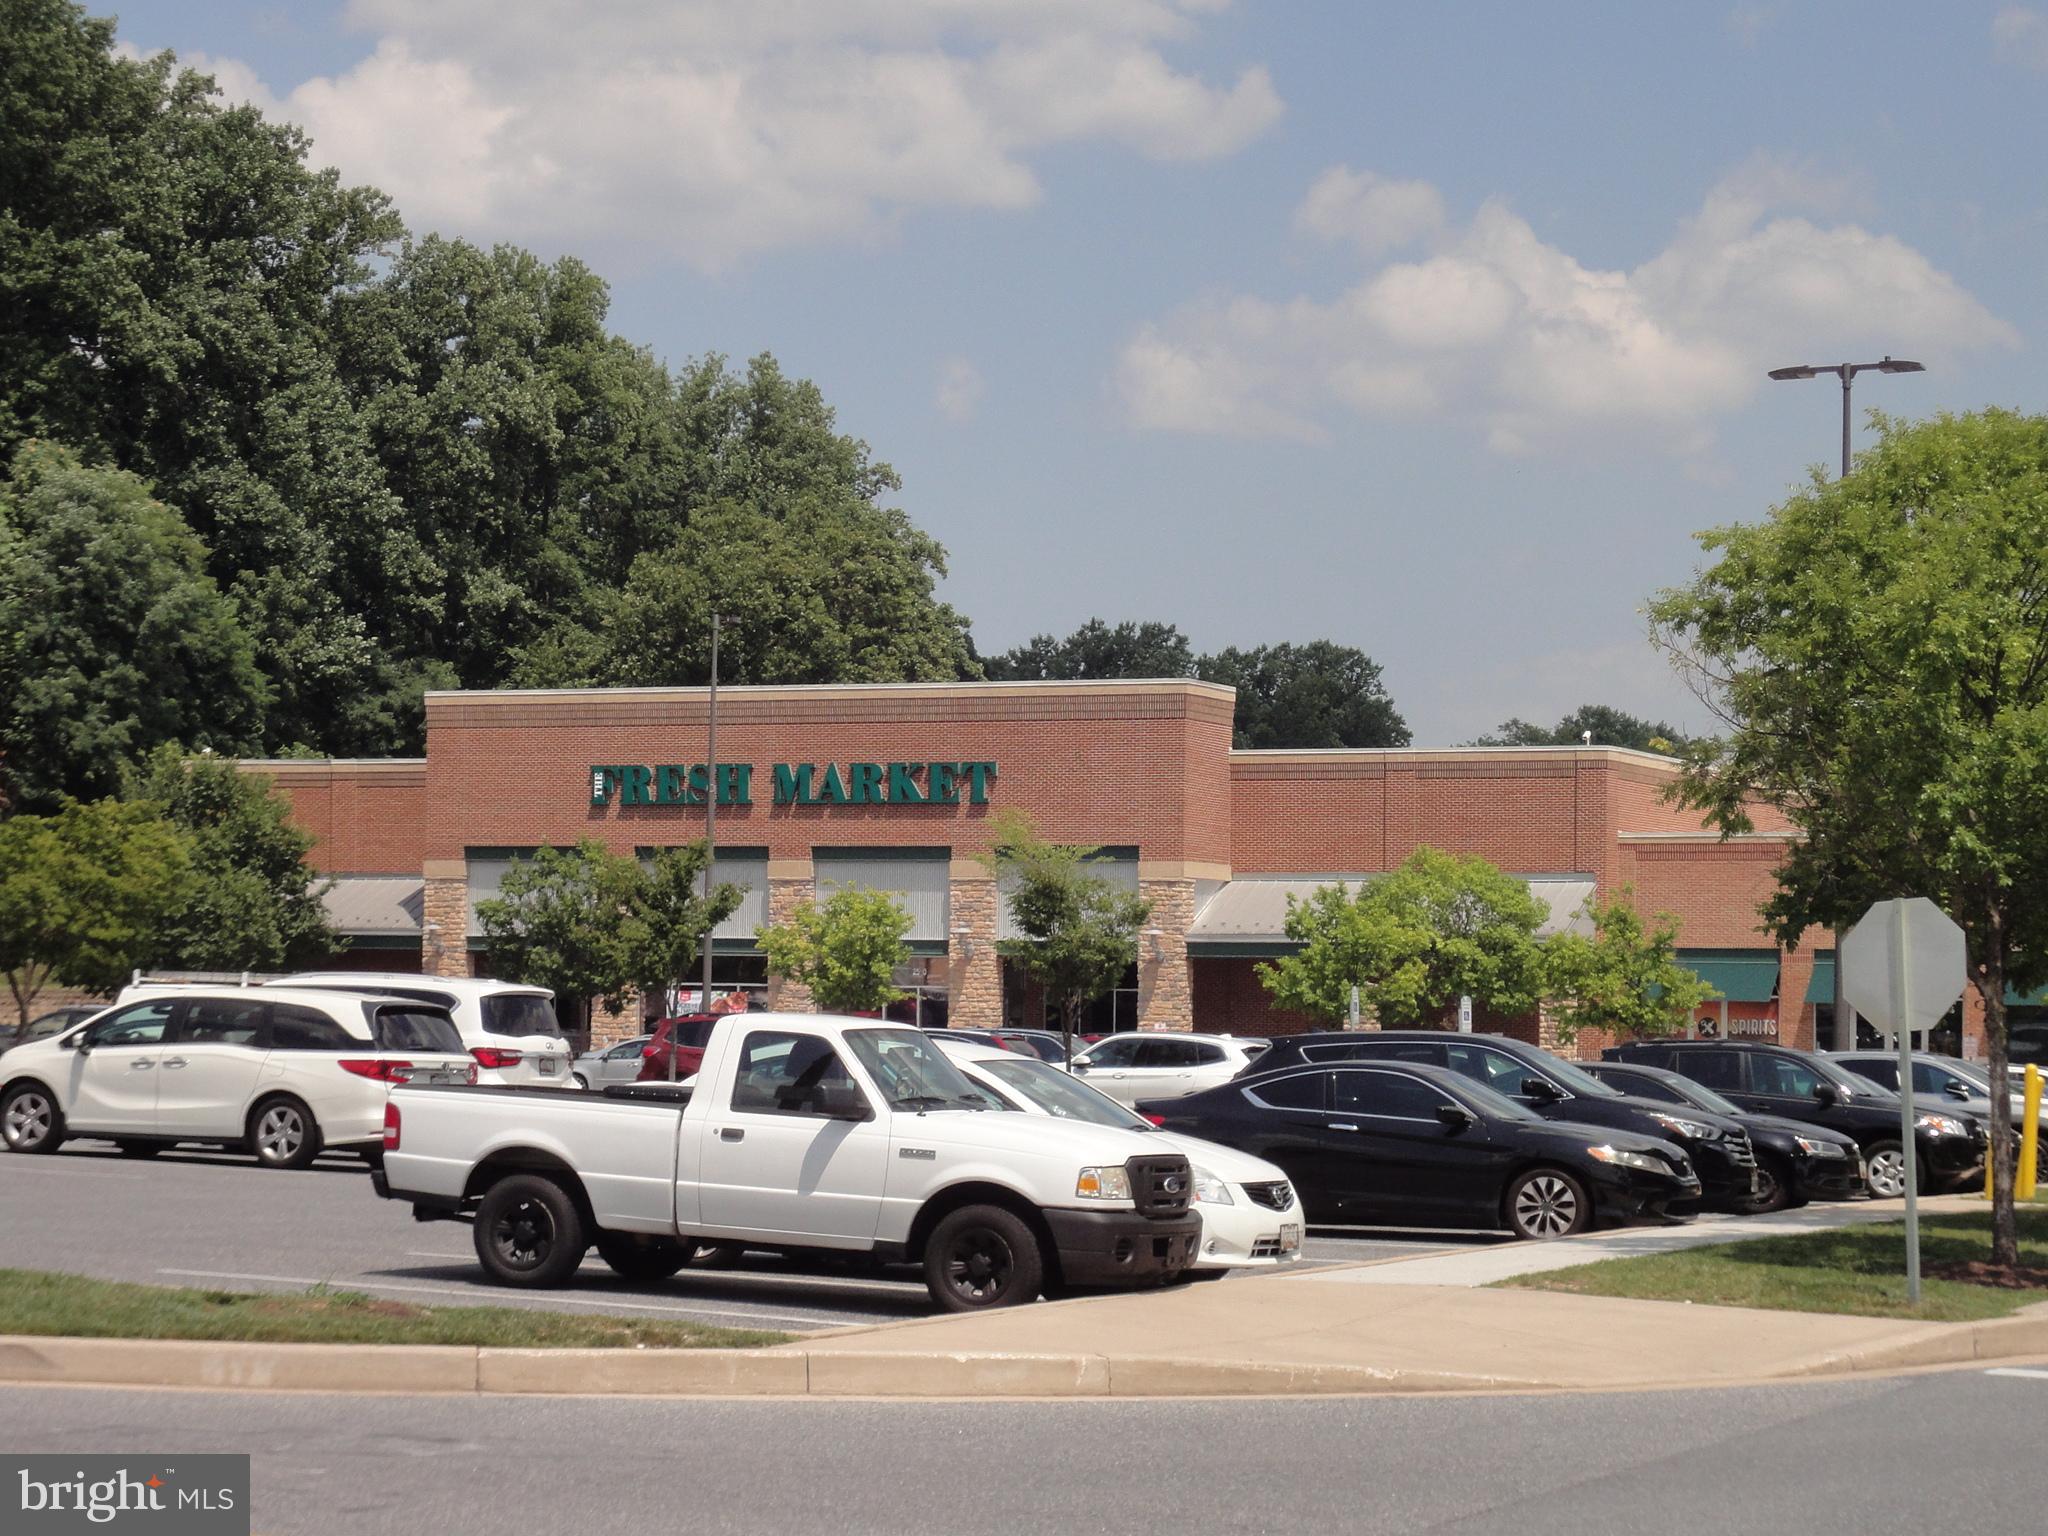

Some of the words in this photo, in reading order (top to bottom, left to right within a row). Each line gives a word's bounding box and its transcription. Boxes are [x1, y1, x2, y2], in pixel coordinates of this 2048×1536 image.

[591, 763, 754, 805] FRESH
[772, 761, 998, 805] MARKET
[594, 772, 603, 798] THE
[1731, 1019, 1777, 1035] SPIRITS
